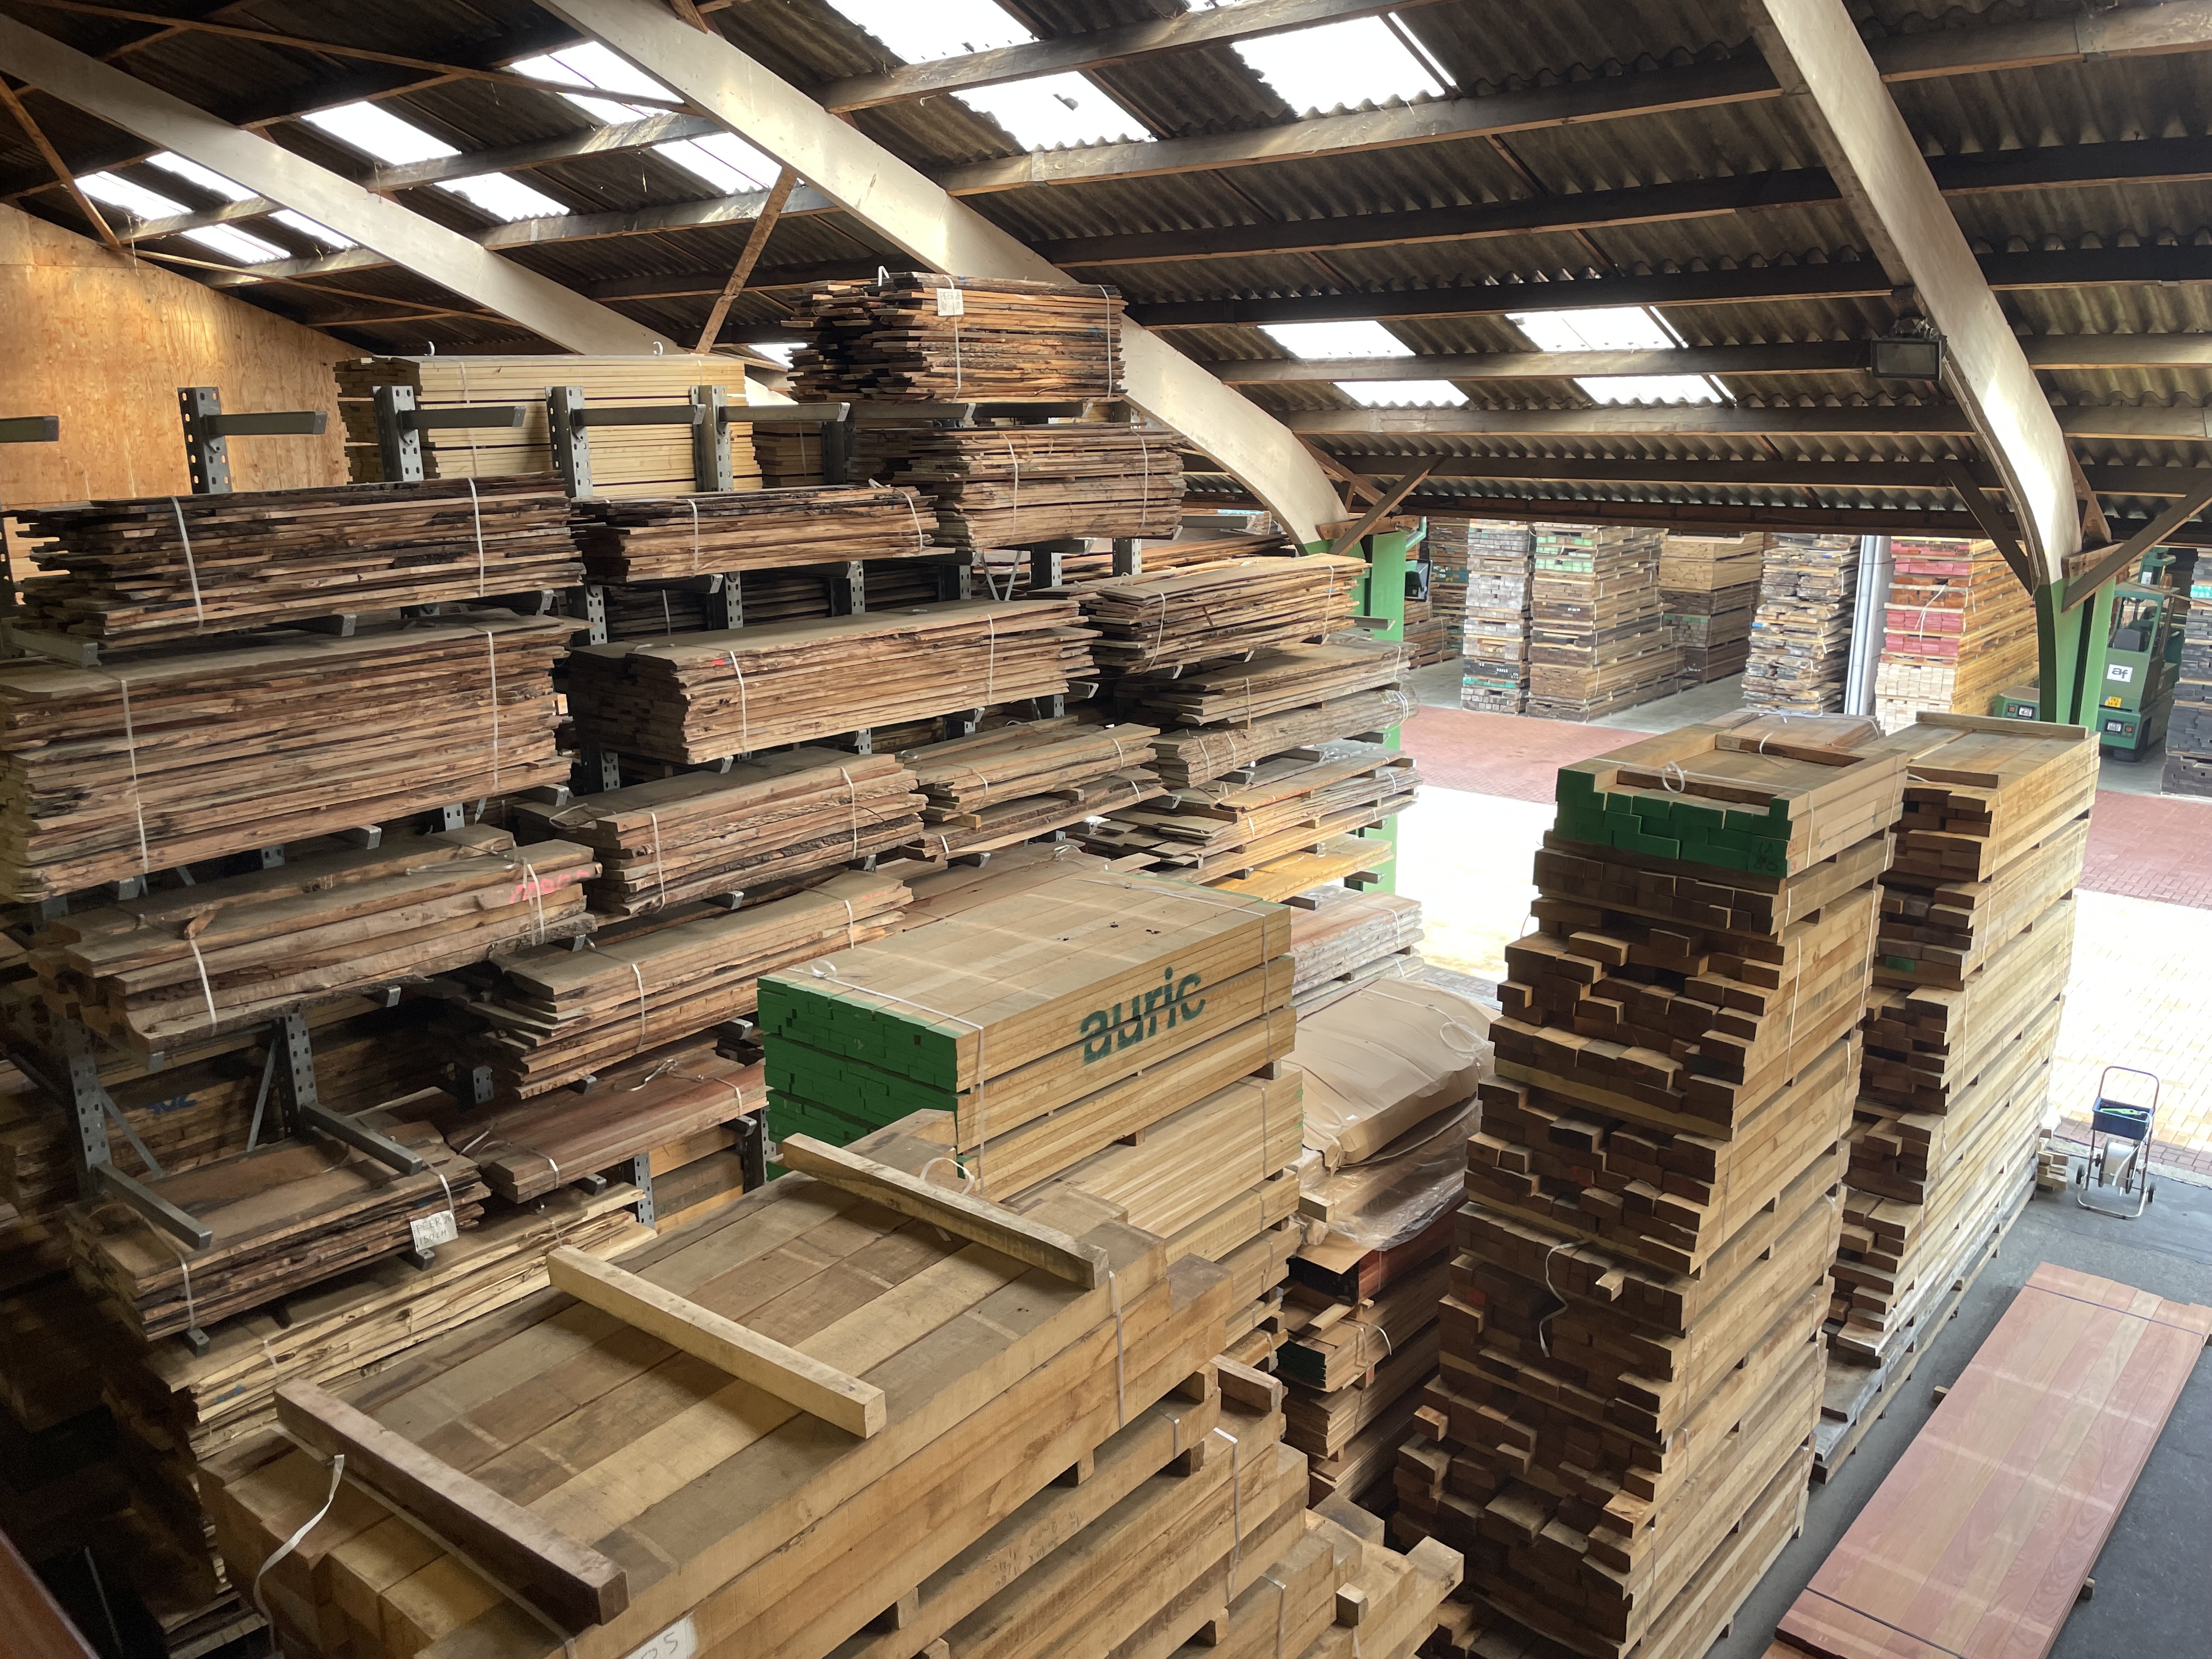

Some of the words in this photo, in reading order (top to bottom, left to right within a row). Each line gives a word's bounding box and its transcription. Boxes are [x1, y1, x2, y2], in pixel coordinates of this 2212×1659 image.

[2112, 667, 2129, 679] af
[1080, 966, 1206, 1066] auric
[416, 1217, 442, 1235] PEER
[444, 1212, 452, 1224] 26
[419, 1233, 435, 1245] 150
